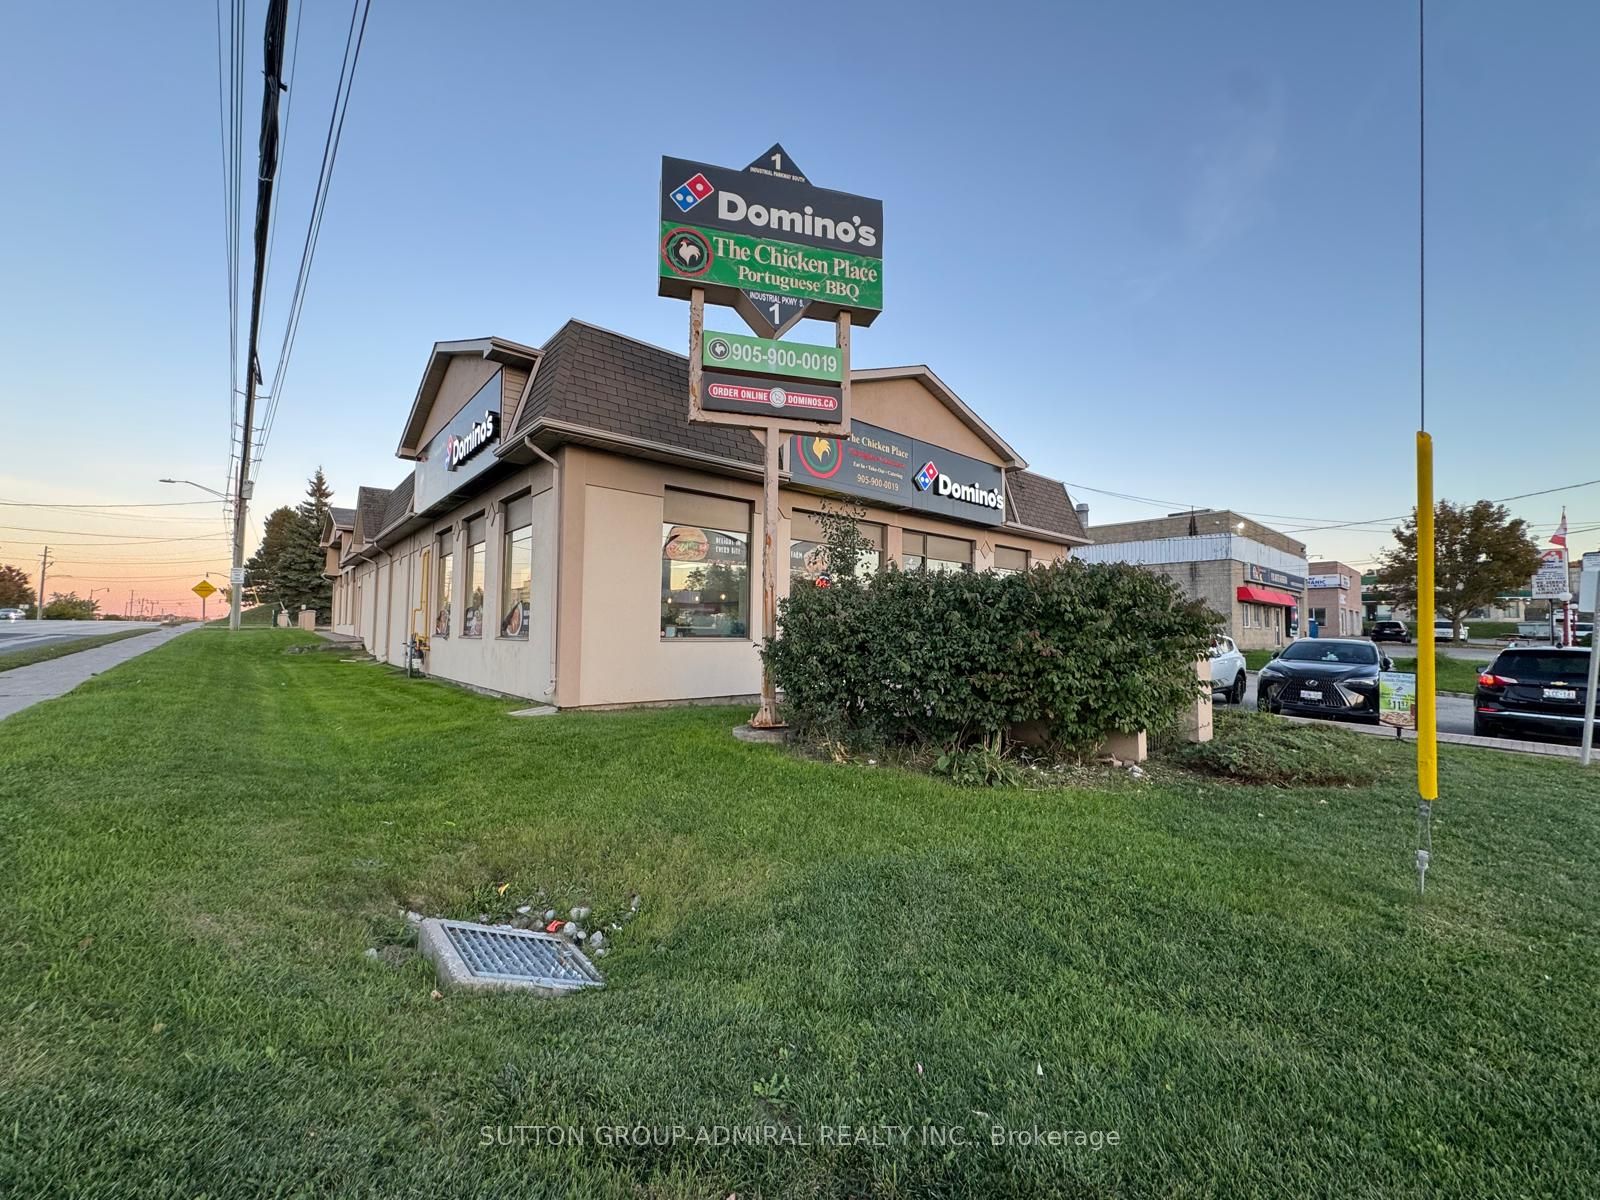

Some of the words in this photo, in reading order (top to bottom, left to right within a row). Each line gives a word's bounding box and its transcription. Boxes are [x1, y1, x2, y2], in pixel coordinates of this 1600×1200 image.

[771, 153, 781, 170] 1
[717, 190, 877, 247] Domino's
[712, 236, 751, 261] The
[754, 244, 828, 275] Chicken
[832, 258, 878, 283] Place
[737, 265, 821, 293] Portuguese
[825, 281, 860, 302] BBQ
[749, 291, 782, 304] INDUSTRIAL
[781, 297, 798, 306] PKWY
[768, 303, 780, 325] 1
[731, 343, 837, 373] 905-900-0019
[712, 386, 739, 397] ORDER
[740, 389, 768, 401] ONLINE
[787, 394, 834, 409] DOMINOS.CA
[452, 409, 493, 466] Domino's
[861, 436, 891, 454] Chicken
[891, 445, 909, 459] Place
[857, 473, 900, 492] 905-900-0019
[938, 474, 1003, 509] Domino's
